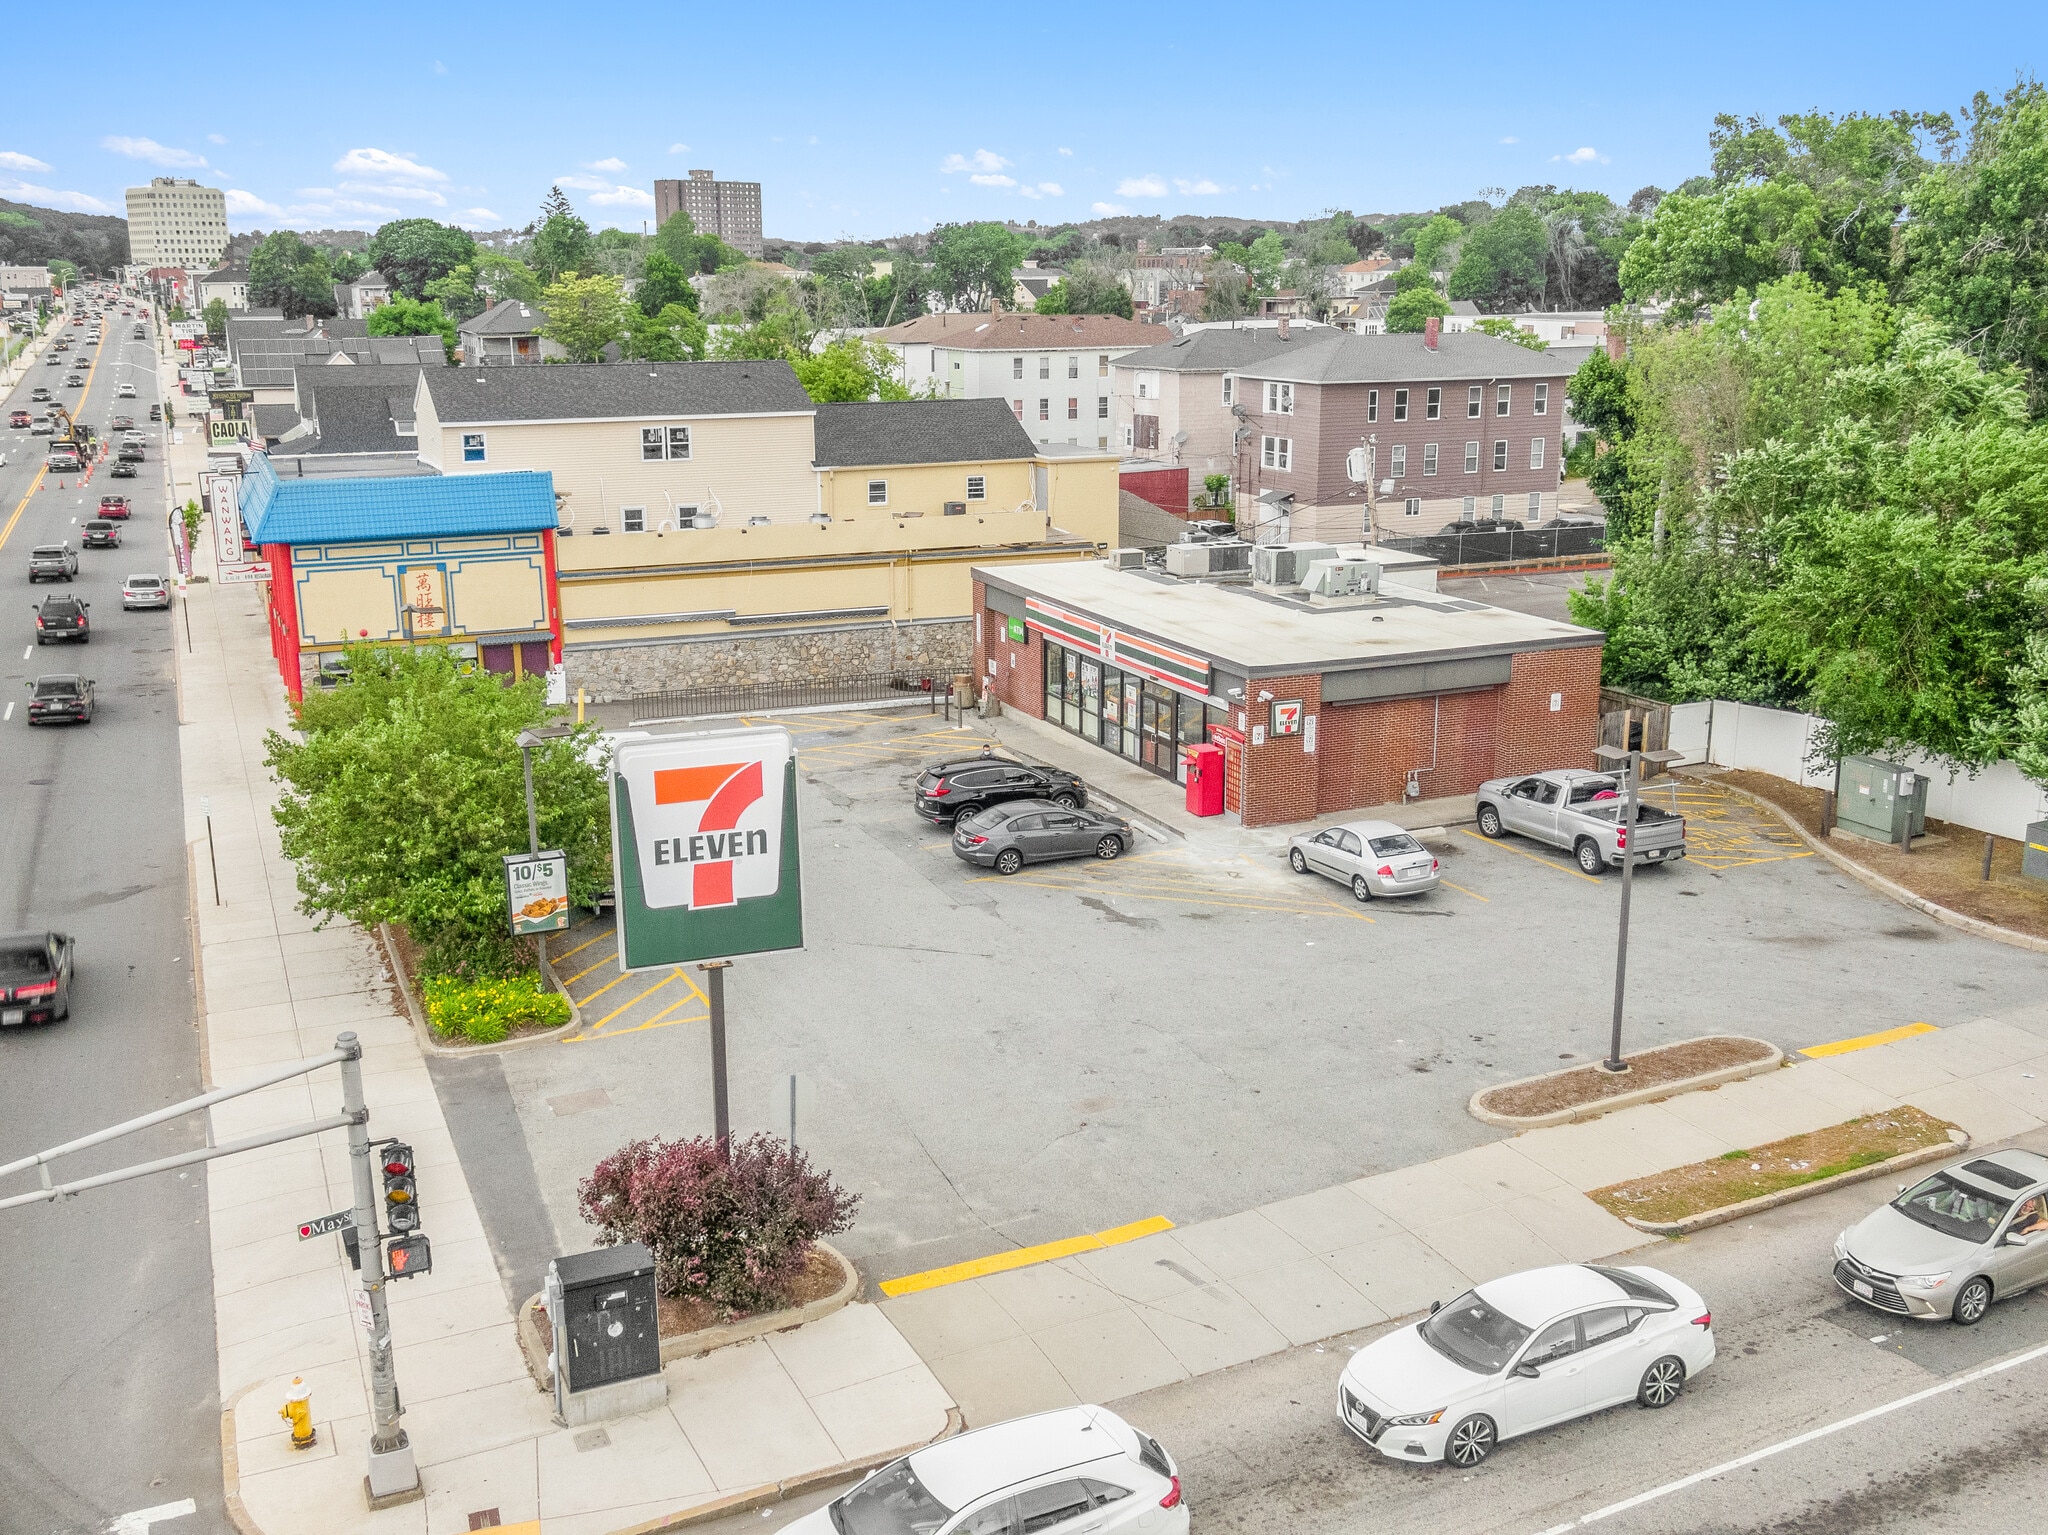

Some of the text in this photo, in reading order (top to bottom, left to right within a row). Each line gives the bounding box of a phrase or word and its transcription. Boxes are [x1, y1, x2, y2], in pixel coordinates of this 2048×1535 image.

[218, 486, 234, 556] WANWANG
[1280, 707, 1298, 733] 7
[653, 760, 764, 908] 7
[513, 882, 532, 890] Classic
[311, 1217, 345, 1235] May
